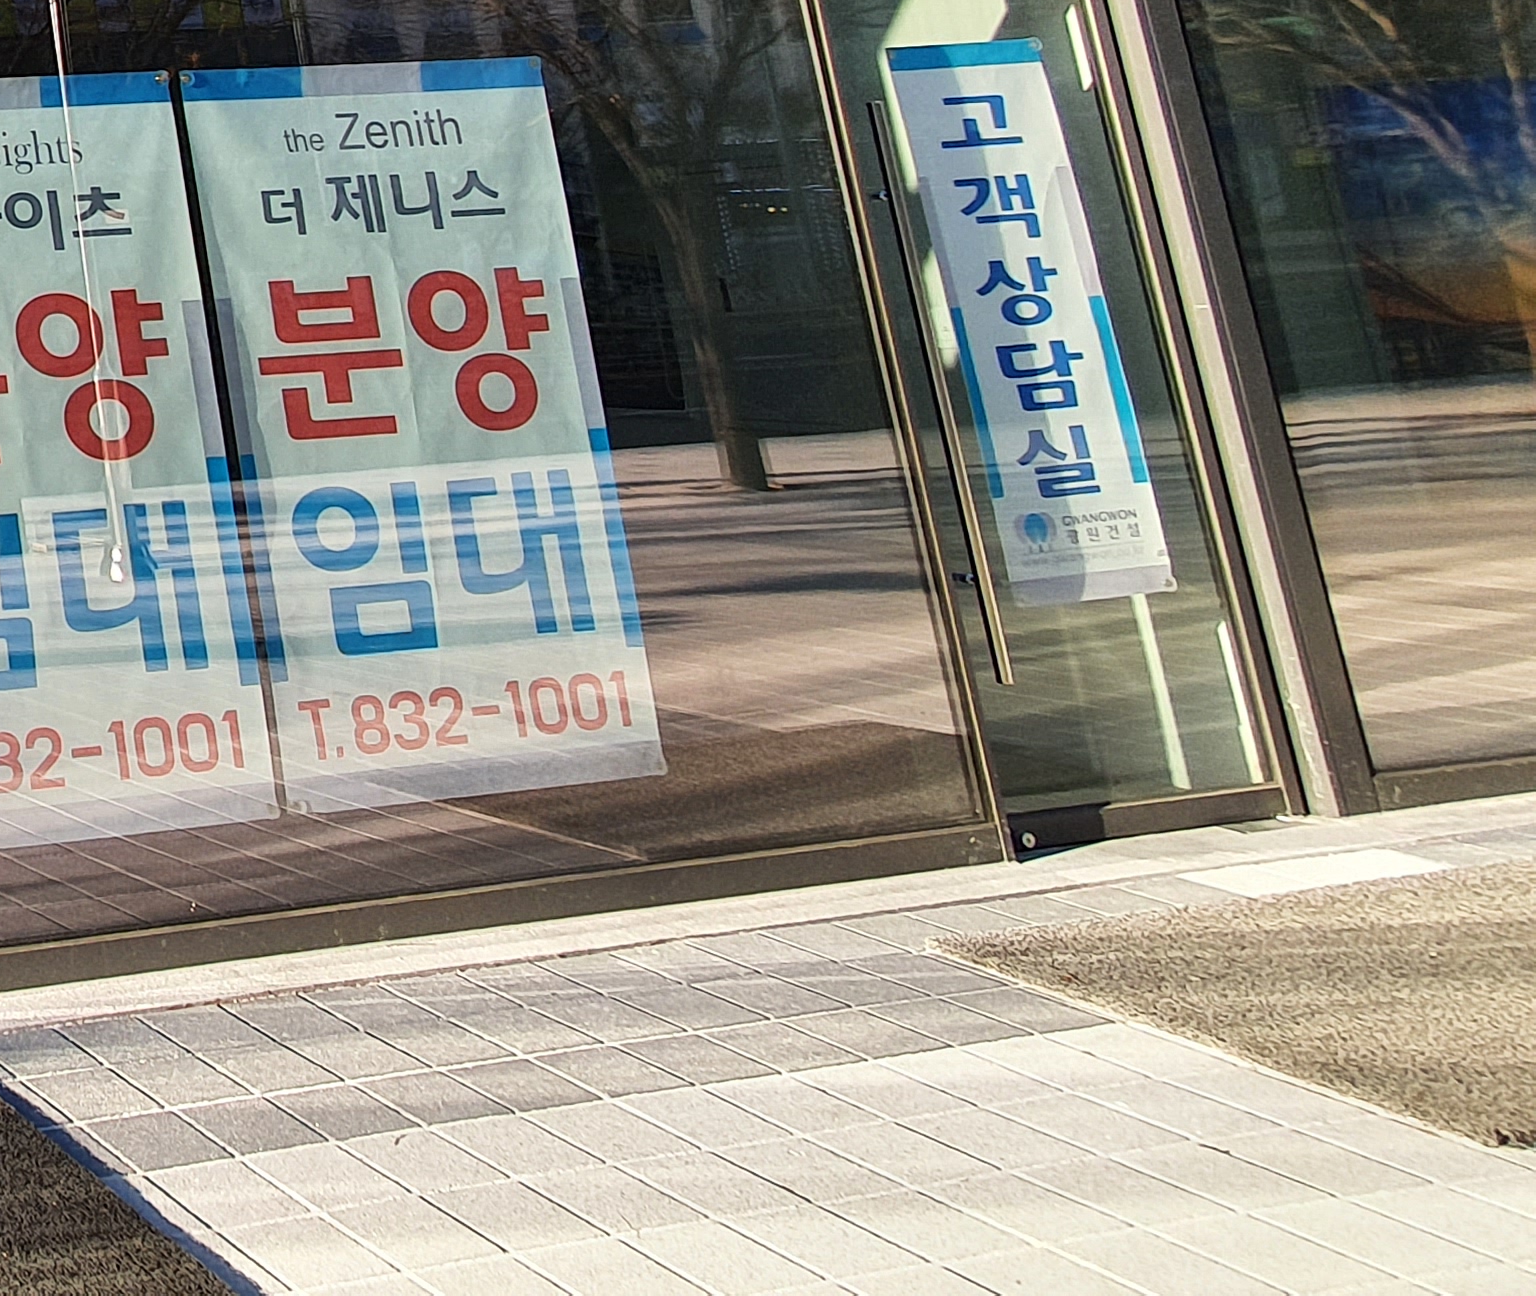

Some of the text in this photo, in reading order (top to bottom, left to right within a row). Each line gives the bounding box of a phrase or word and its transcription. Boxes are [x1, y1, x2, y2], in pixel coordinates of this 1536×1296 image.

[283, 110, 464, 154] the Zenith
[261, 169, 507, 236] 더 제니스
[259, 266, 550, 440] 분양
[941, 94, 1101, 499] 고객상담실
[291, 468, 596, 656] 임대
[298, 669, 633, 760] T.832-1001
